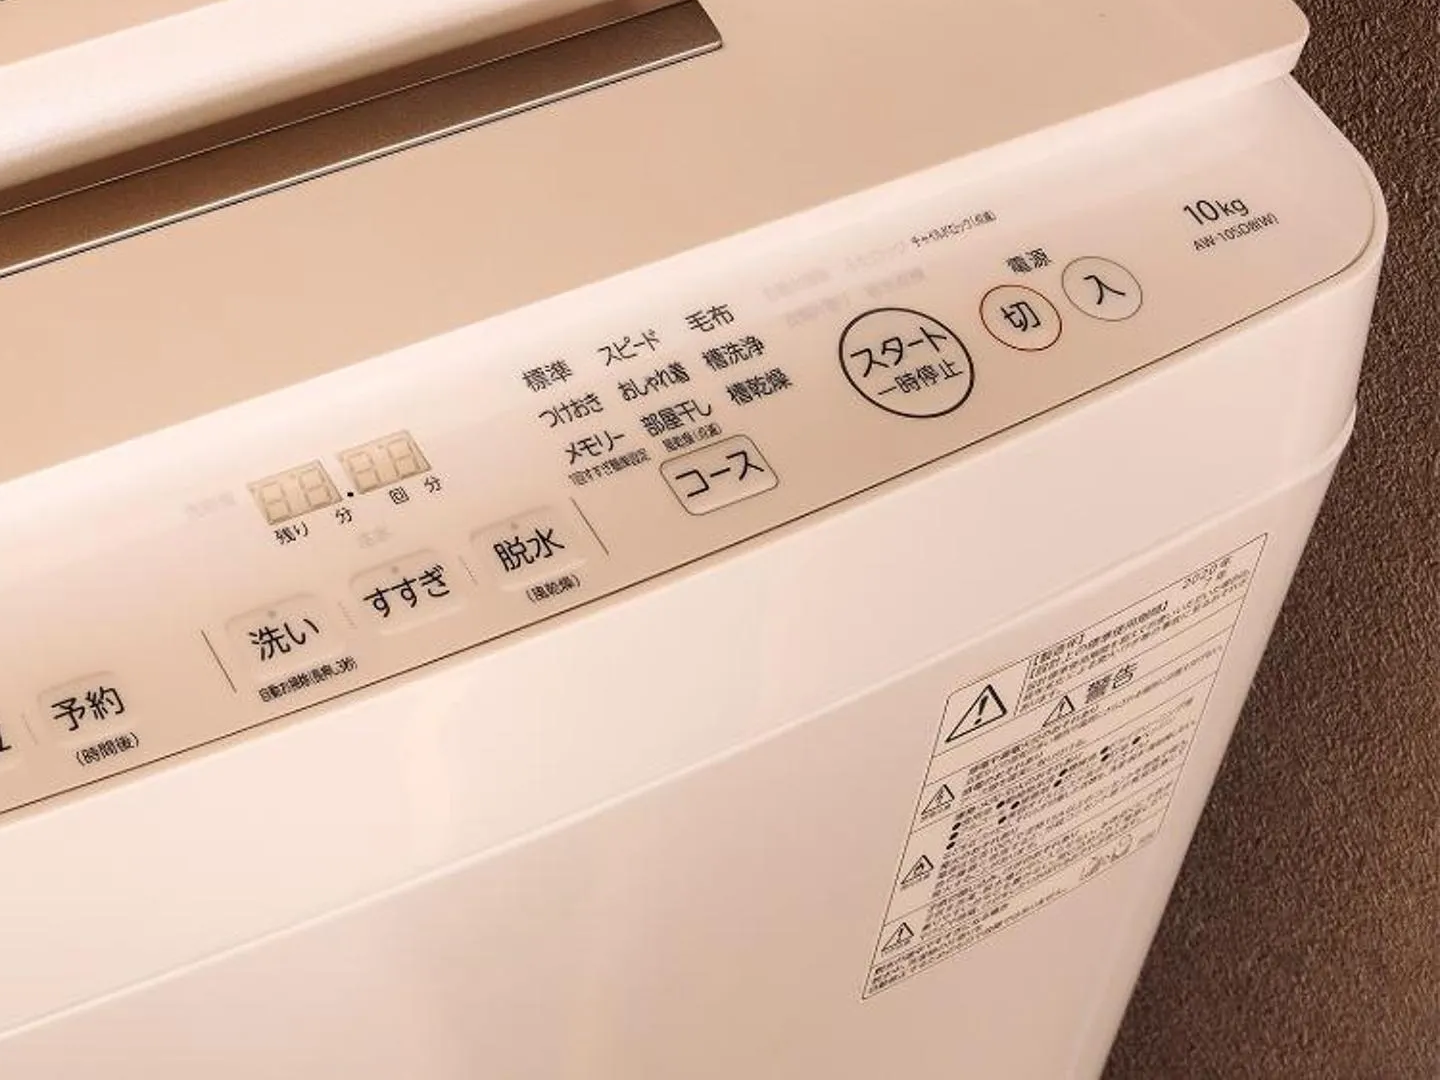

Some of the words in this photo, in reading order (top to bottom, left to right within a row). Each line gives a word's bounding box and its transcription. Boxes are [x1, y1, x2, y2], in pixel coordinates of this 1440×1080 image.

[1183, 199, 1249, 225] 10kg
[1007, 248, 1051, 274] 電源
[1083, 274, 1127, 305] 入
[1000, 301, 1041, 332] 切
[522, 359, 574, 393] 標準
[598, 328, 661, 366] スピード
[685, 303, 735, 333] 毛布
[850, 326, 947, 377] スタート
[538, 392, 604, 428] つけおき
[701, 335, 765, 372] 槽洗浄
[877, 359, 964, 395] 一時停止
[565, 429, 625, 465] メモリー
[640, 399, 712, 437] 部屋干し
[675, 450, 765, 498] コース
[274, 523, 309, 546] 残り
[335, 507, 354, 526] 分
[424, 475, 442, 494] 分
[494, 527, 565, 572] 脱水
[363, 564, 451, 618] すすぎ
[249, 617, 319, 662] 洗い
[50, 686, 126, 732] 予約
